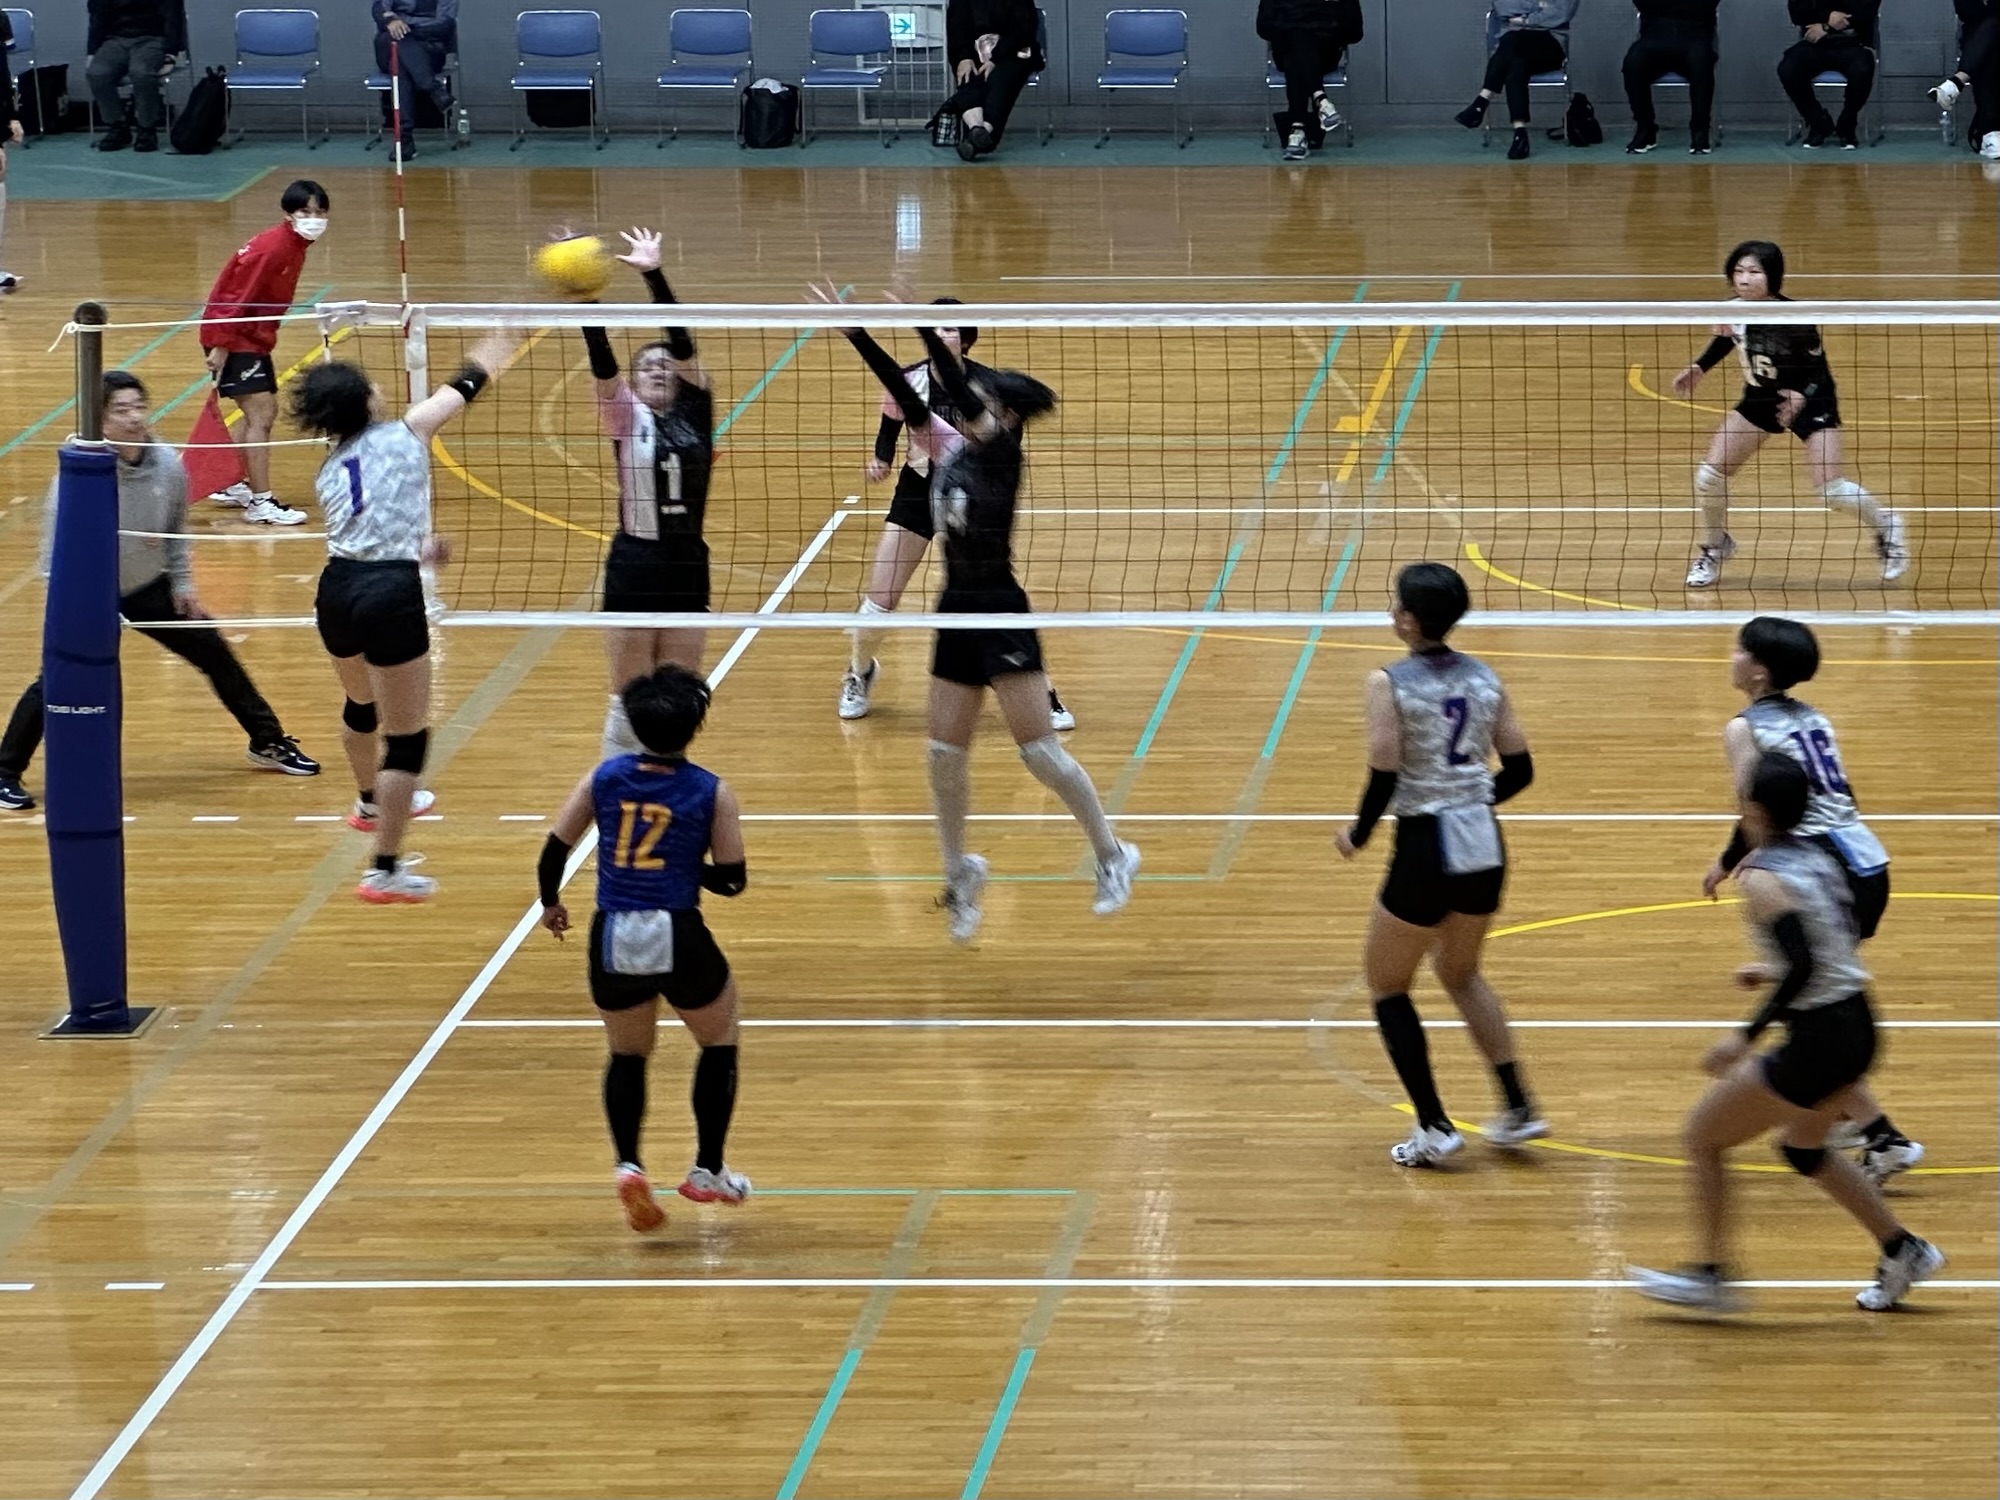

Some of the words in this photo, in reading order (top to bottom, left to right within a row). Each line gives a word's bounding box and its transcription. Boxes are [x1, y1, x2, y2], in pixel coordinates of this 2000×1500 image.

[341, 456, 364, 516] 1
[660, 452, 683, 502] 1
[1442, 697, 1470, 765] 2
[1790, 729, 1846, 796] 16
[614, 801, 673, 870] 12
